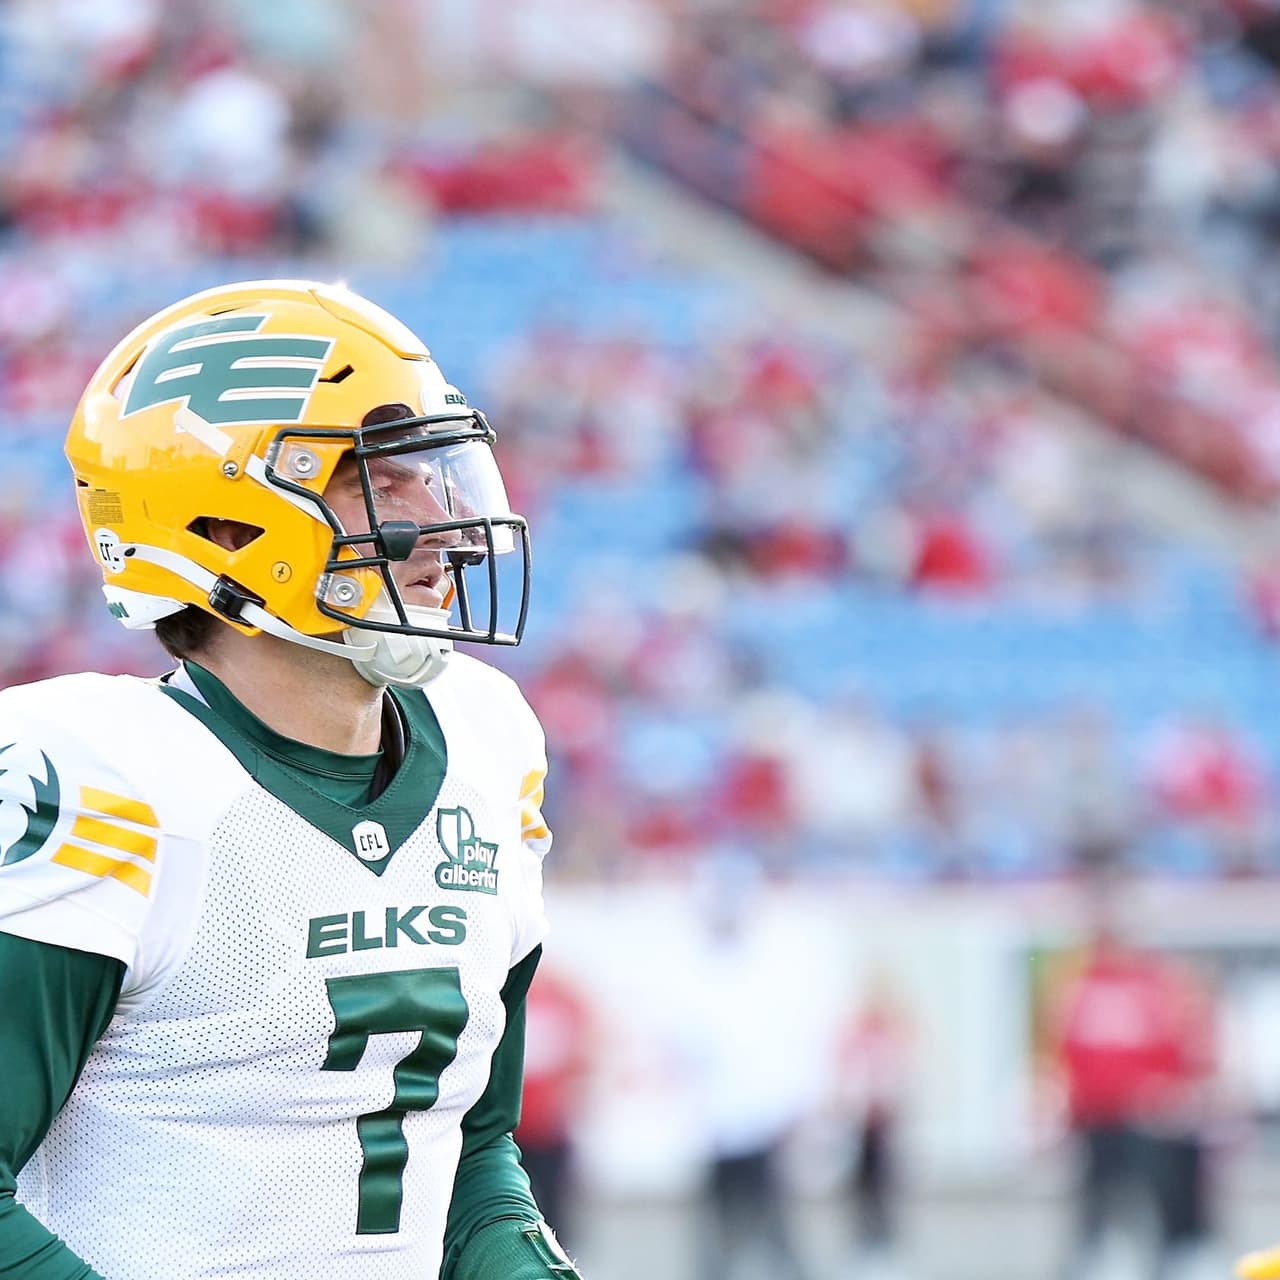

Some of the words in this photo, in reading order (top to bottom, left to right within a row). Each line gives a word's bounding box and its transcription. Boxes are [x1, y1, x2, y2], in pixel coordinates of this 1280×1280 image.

[360, 832, 383, 851] CFL
[464, 842, 495, 869] play
[439, 864, 497, 889] alberta
[306, 905, 468, 958] ELKS
[320, 966, 470, 1235] 7
